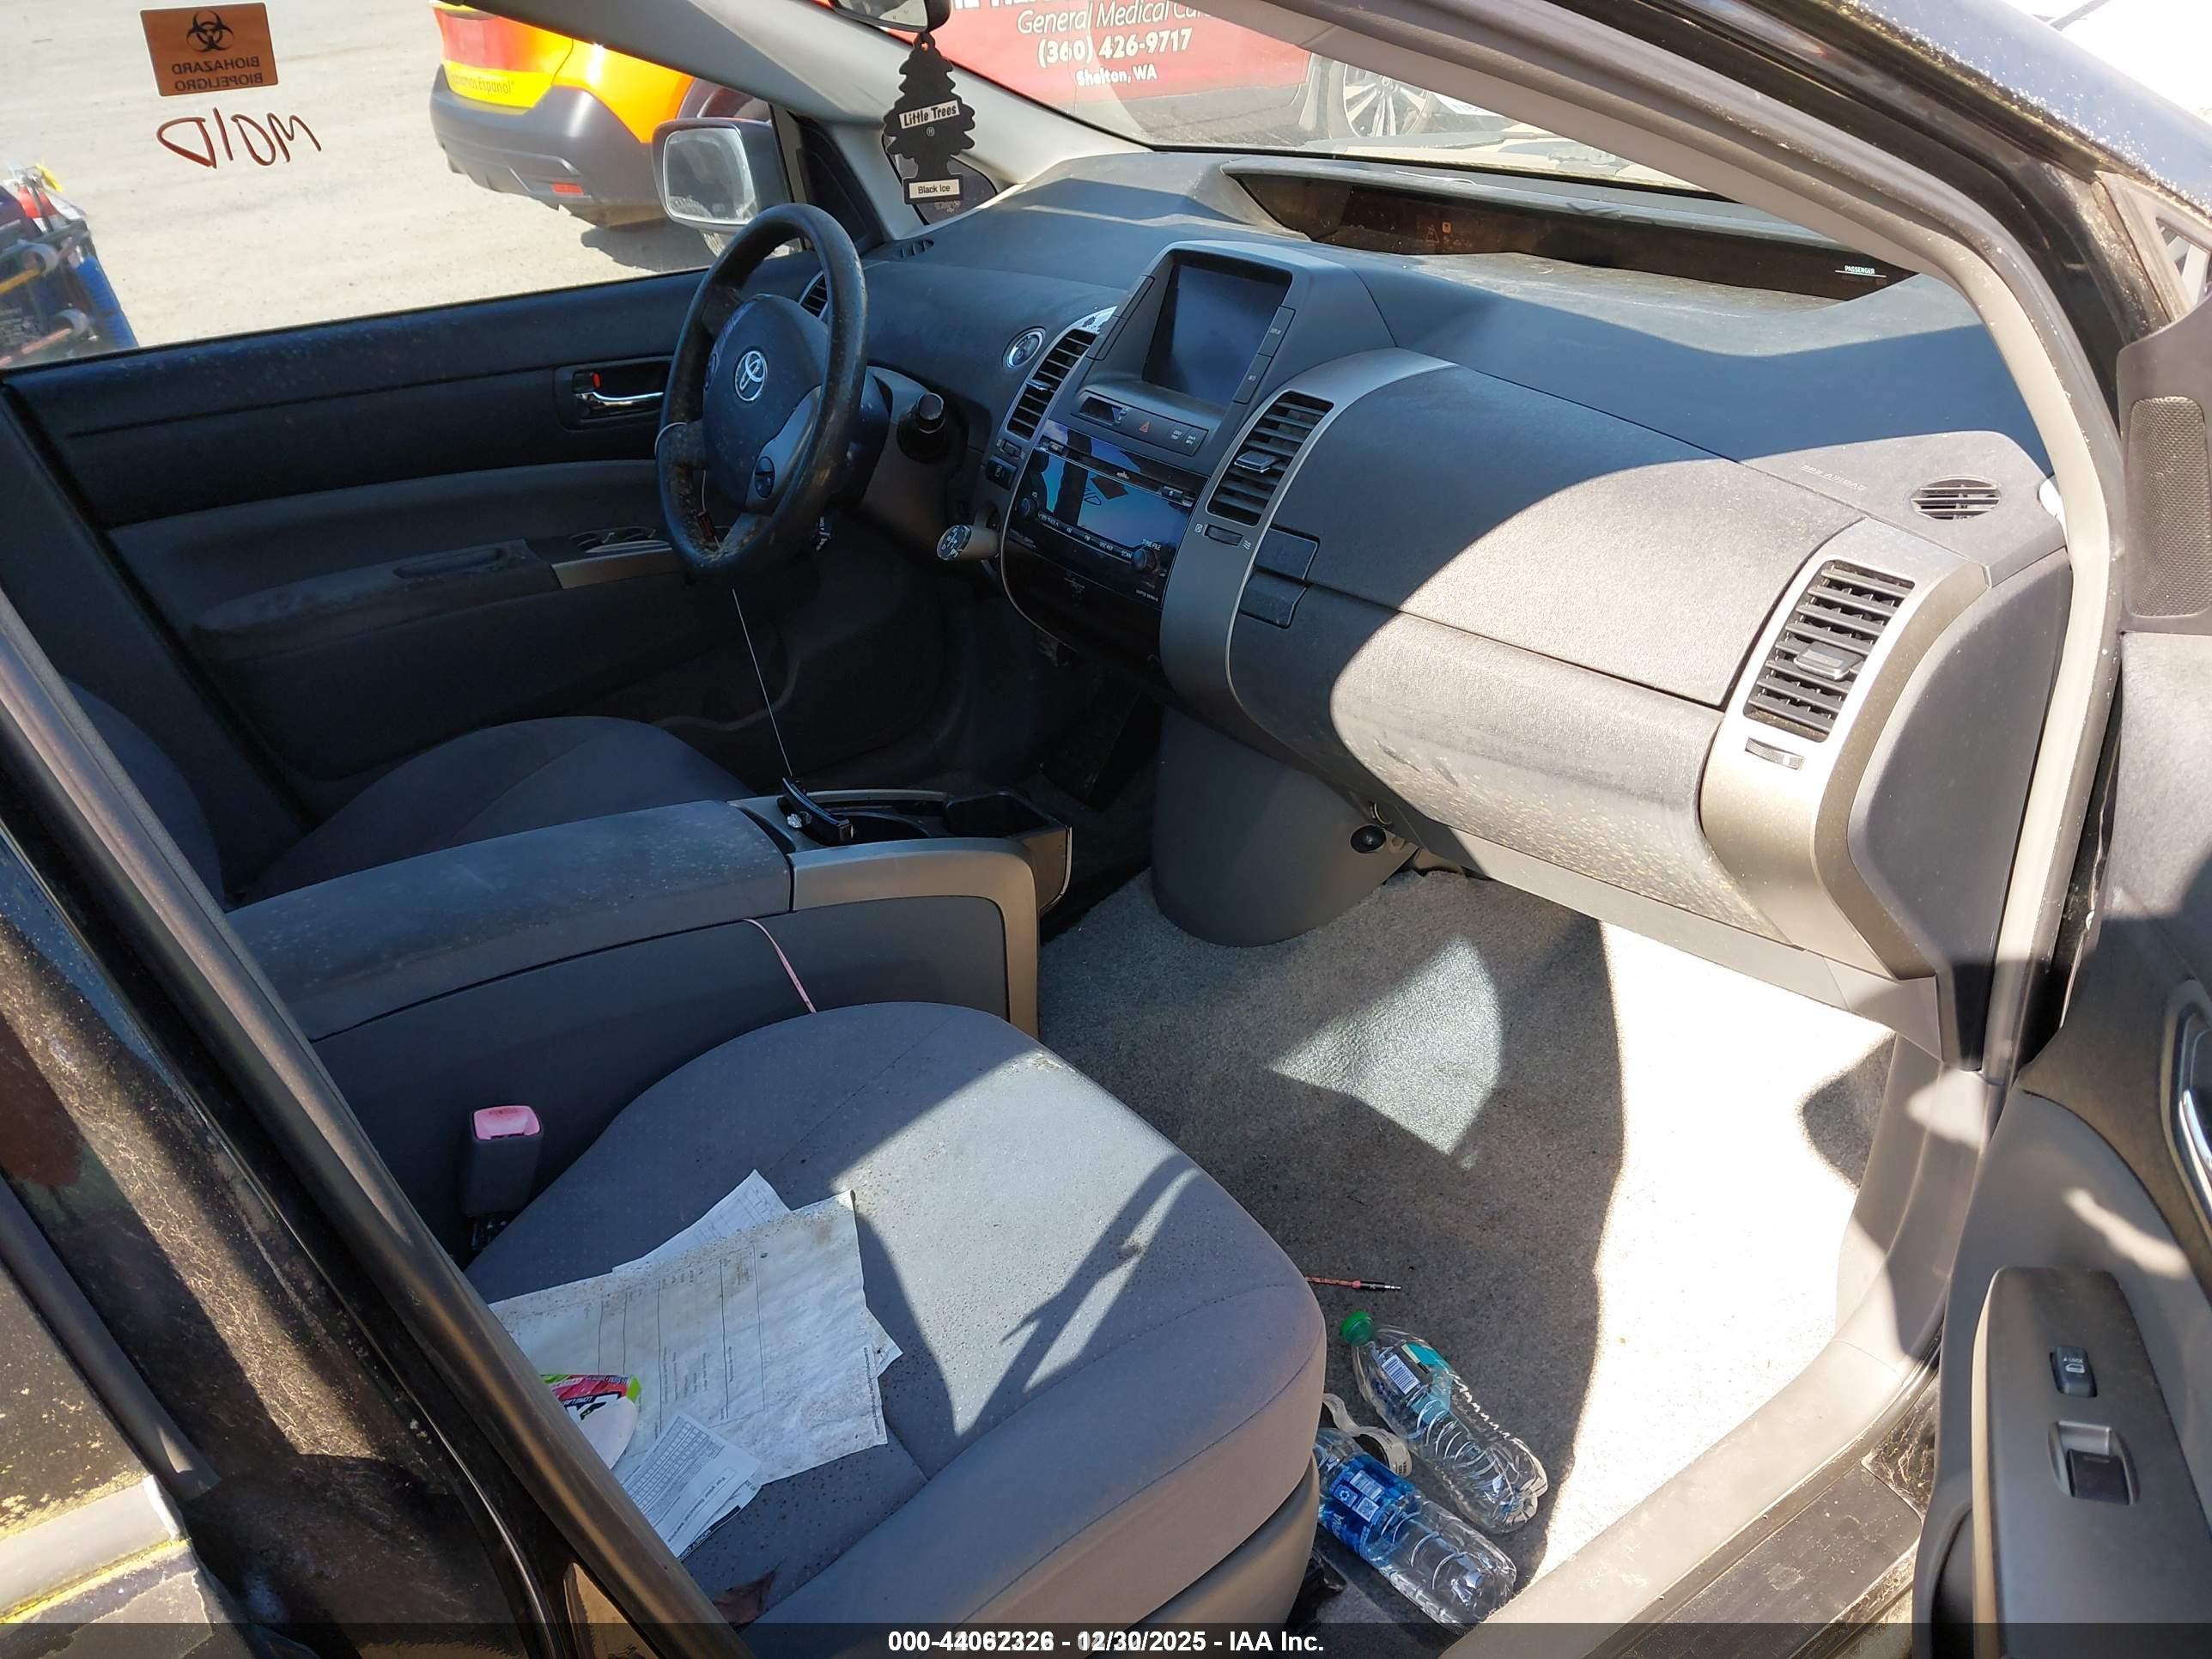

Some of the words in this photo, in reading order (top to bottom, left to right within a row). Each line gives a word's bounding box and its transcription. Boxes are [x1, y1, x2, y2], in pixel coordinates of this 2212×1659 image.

[1017, 2, 1092, 34] General
[1096, 0, 1170, 28] Medical
[1173, 2, 1210, 19] Ca
[1037, 35, 1093, 69] (360)
[1098, 27, 1193, 59] 426-9717
[1075, 66, 1132, 87] Shelton,
[1132, 64, 1158, 81] WA
[903, 109, 929, 127] Little
[931, 105, 957, 119] Trees
[918, 184, 938, 194] Black
[939, 183, 951, 192] Ice
[1844, 264, 1875, 275] PASSENGER
